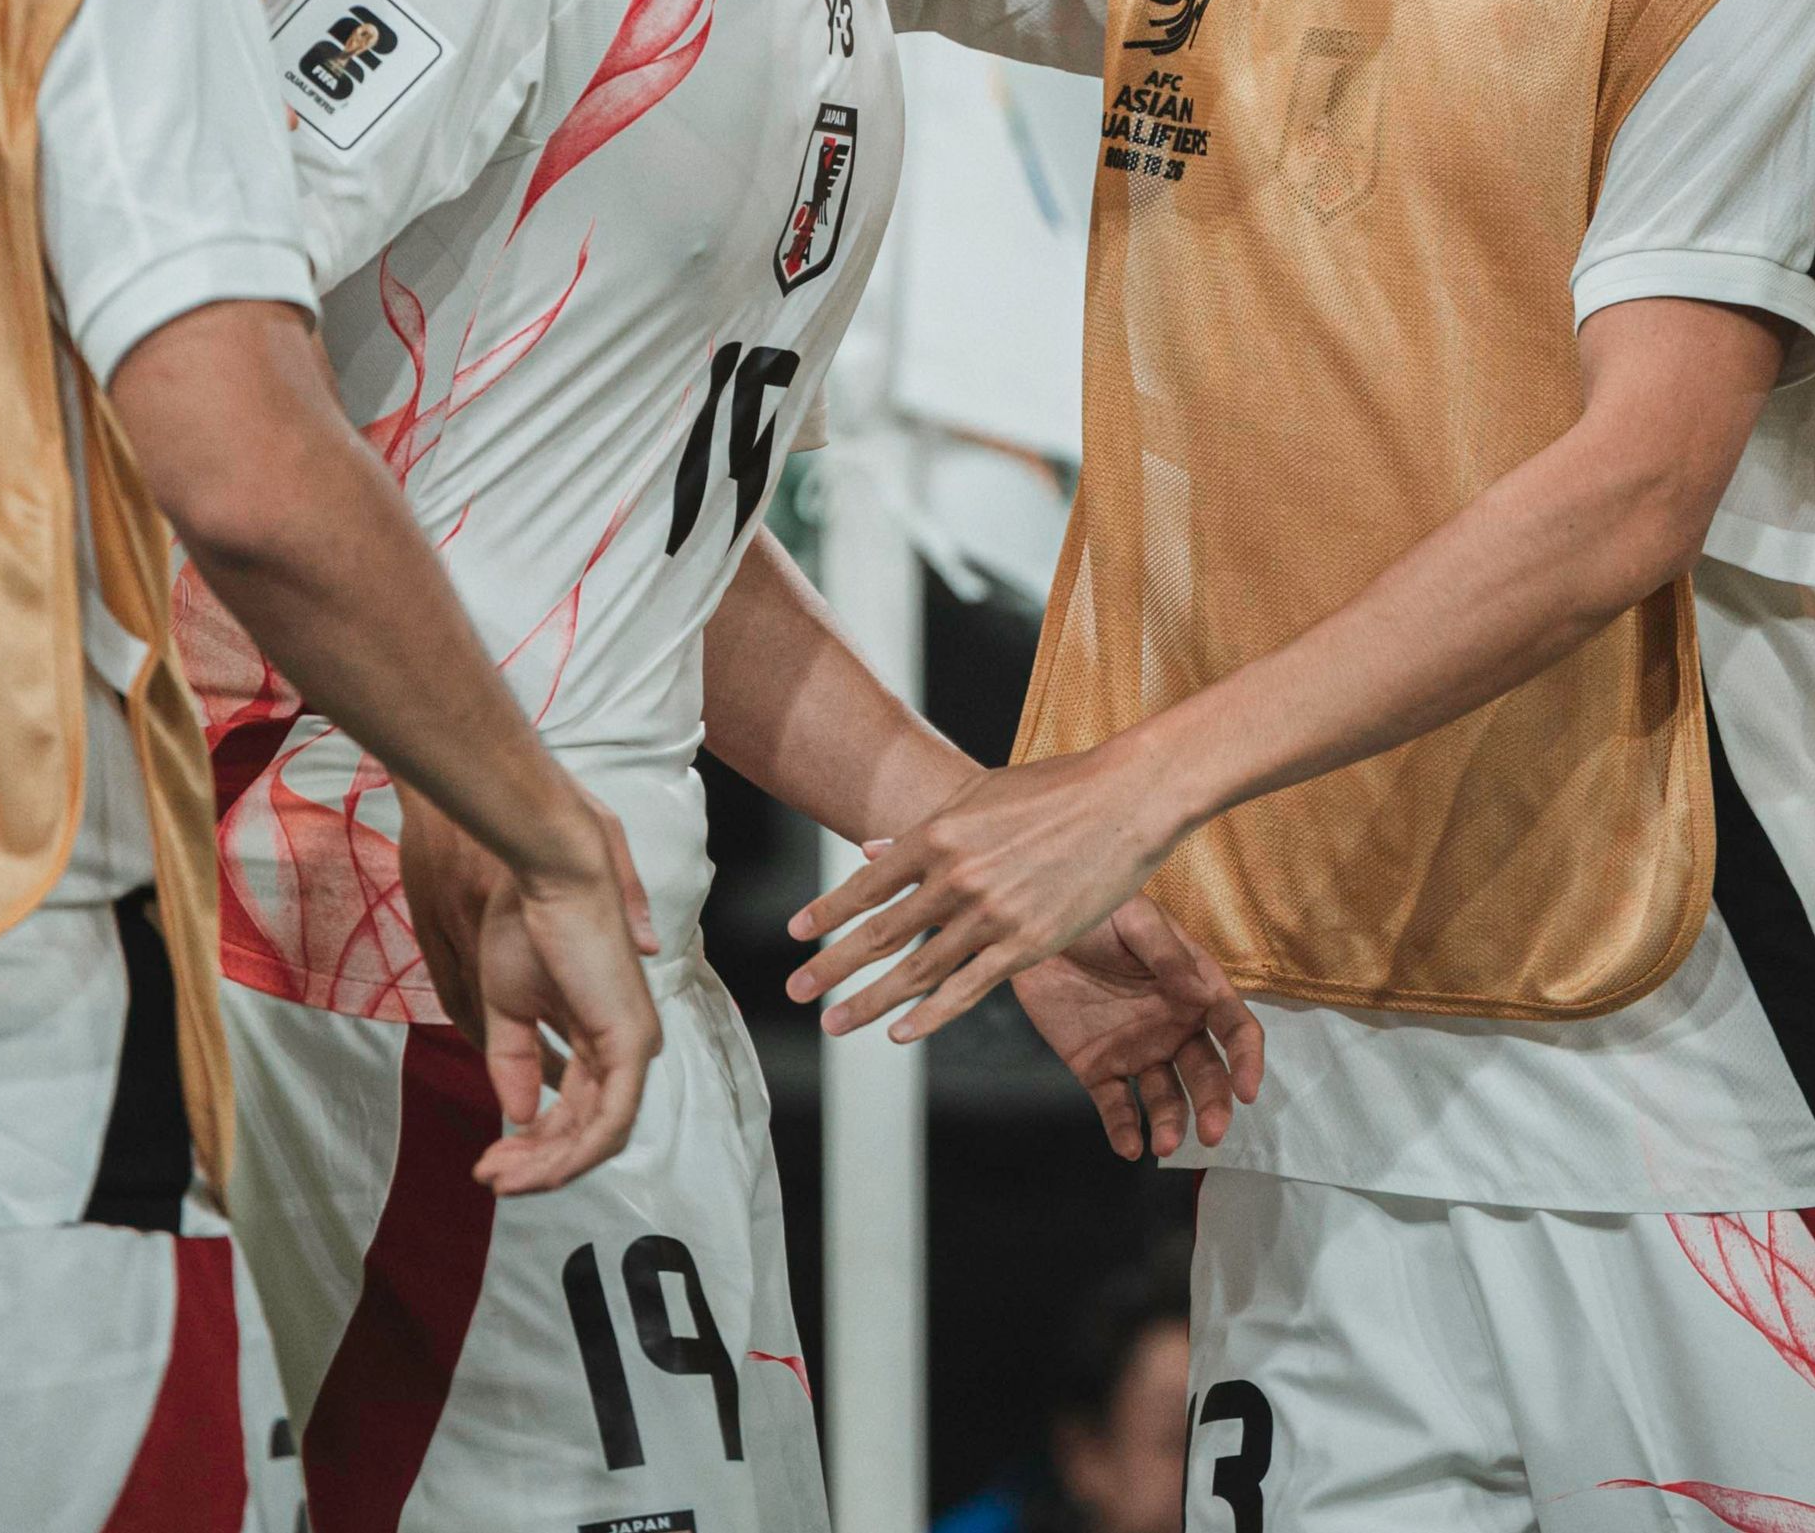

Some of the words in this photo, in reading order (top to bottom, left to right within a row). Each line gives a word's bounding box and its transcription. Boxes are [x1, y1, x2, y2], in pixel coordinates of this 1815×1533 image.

[311, 64, 338, 91] FIFA
[1144, 70, 1183, 92] AFC
[822, 108, 847, 127] JAPAN
[1112, 84, 1194, 123] ASIAN
[1102, 112, 1208, 156] UALIFIERS
[562, 1234, 744, 1471] 19
[1184, 1379, 1273, 1533] 3
[608, 1516, 671, 1533] JAPAN
